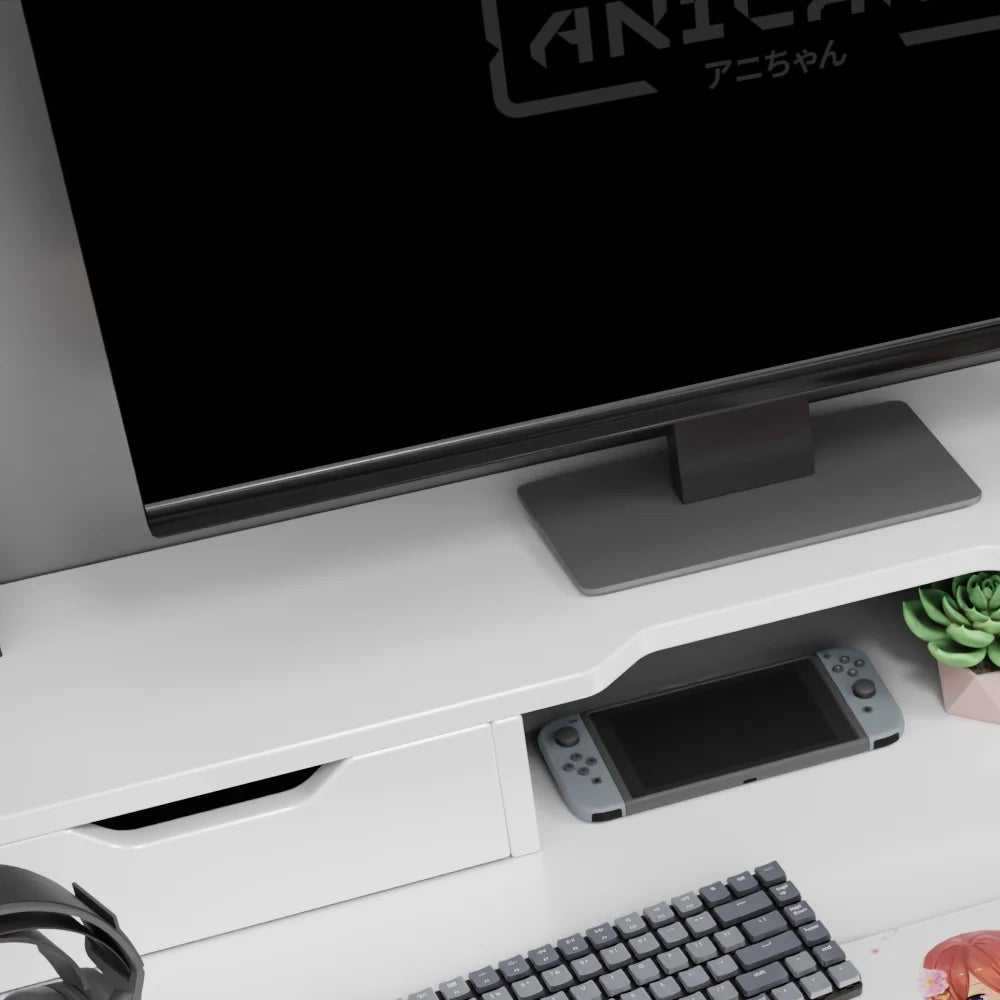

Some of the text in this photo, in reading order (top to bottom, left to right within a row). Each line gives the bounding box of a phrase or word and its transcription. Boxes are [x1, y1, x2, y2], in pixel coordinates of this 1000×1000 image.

[705, 39, 847, 89] アニちゃん
